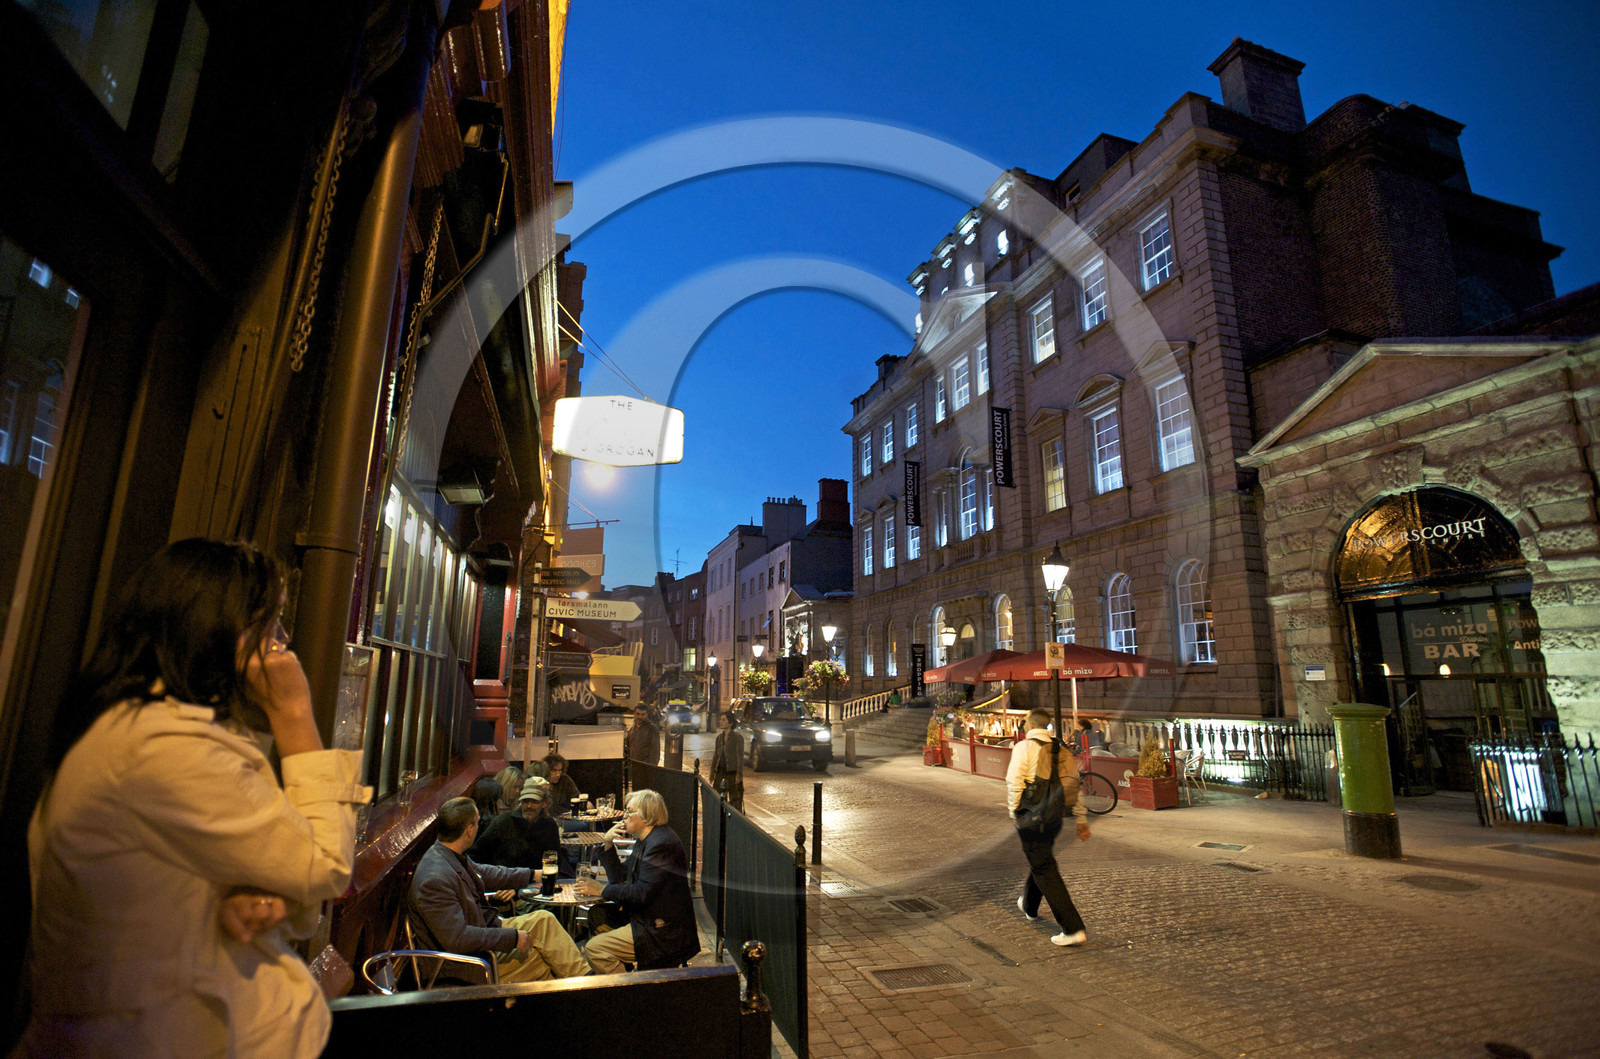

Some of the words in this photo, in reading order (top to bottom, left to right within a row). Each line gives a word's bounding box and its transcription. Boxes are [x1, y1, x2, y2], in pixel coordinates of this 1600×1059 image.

[609, 399, 633, 410] THE
[993, 409, 1005, 485] POWERSCOURT
[906, 463, 915, 524] POWERSCOURT
[1354, 516, 1486, 552] POWERSCOURT
[1419, 528, 1486, 546] CENTRE
[548, 607, 575, 616] CIVIC
[576, 609, 617, 618] MUSEUM
[1411, 622, 1436, 639] bá
[1440, 618, 1488, 637] mizu
[1507, 618, 1538, 630] POW
[1423, 642, 1481, 659] BAR
[1513, 638, 1540, 650] Anti
[1062, 667, 1073, 675] bá
[1074, 666, 1093, 675] mizu
[1117, 780, 1131, 788] AMS
